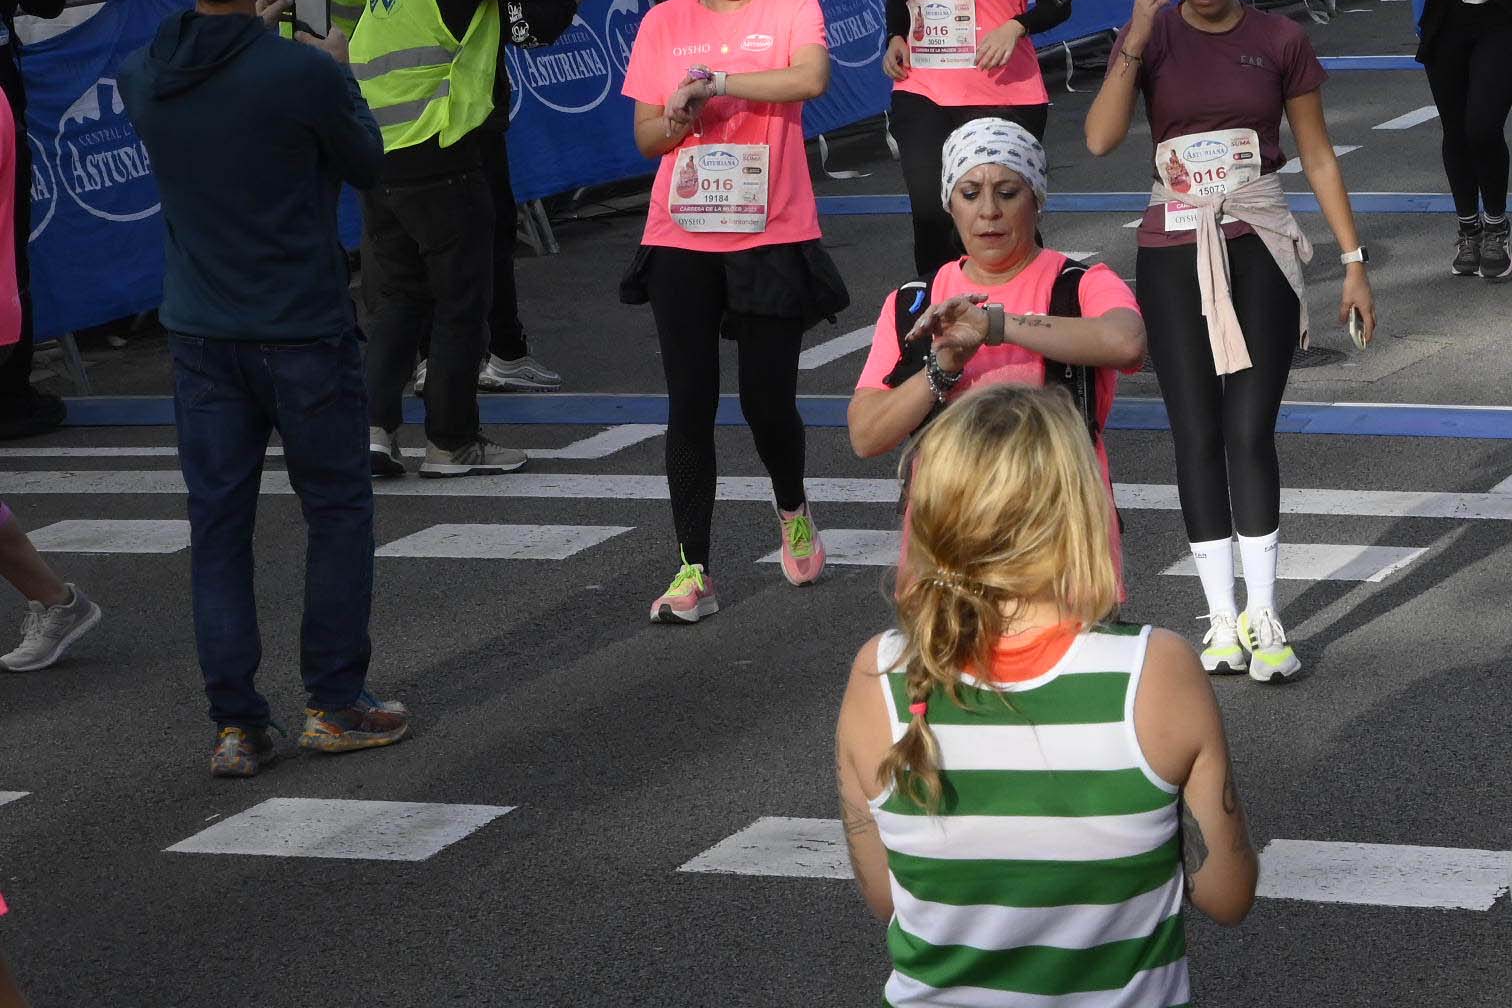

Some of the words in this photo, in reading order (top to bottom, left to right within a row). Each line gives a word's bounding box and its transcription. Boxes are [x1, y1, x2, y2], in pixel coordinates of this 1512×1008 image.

[925, 25, 949, 36] 016
[523, 47, 608, 88] ASTURIANA
[70, 138, 152, 196] ASTURIA
[1193, 166, 1227, 184] 016
[701, 178, 734, 191] 016
[1198, 184, 1226, 196] 15073
[704, 194, 729, 203] 19184
